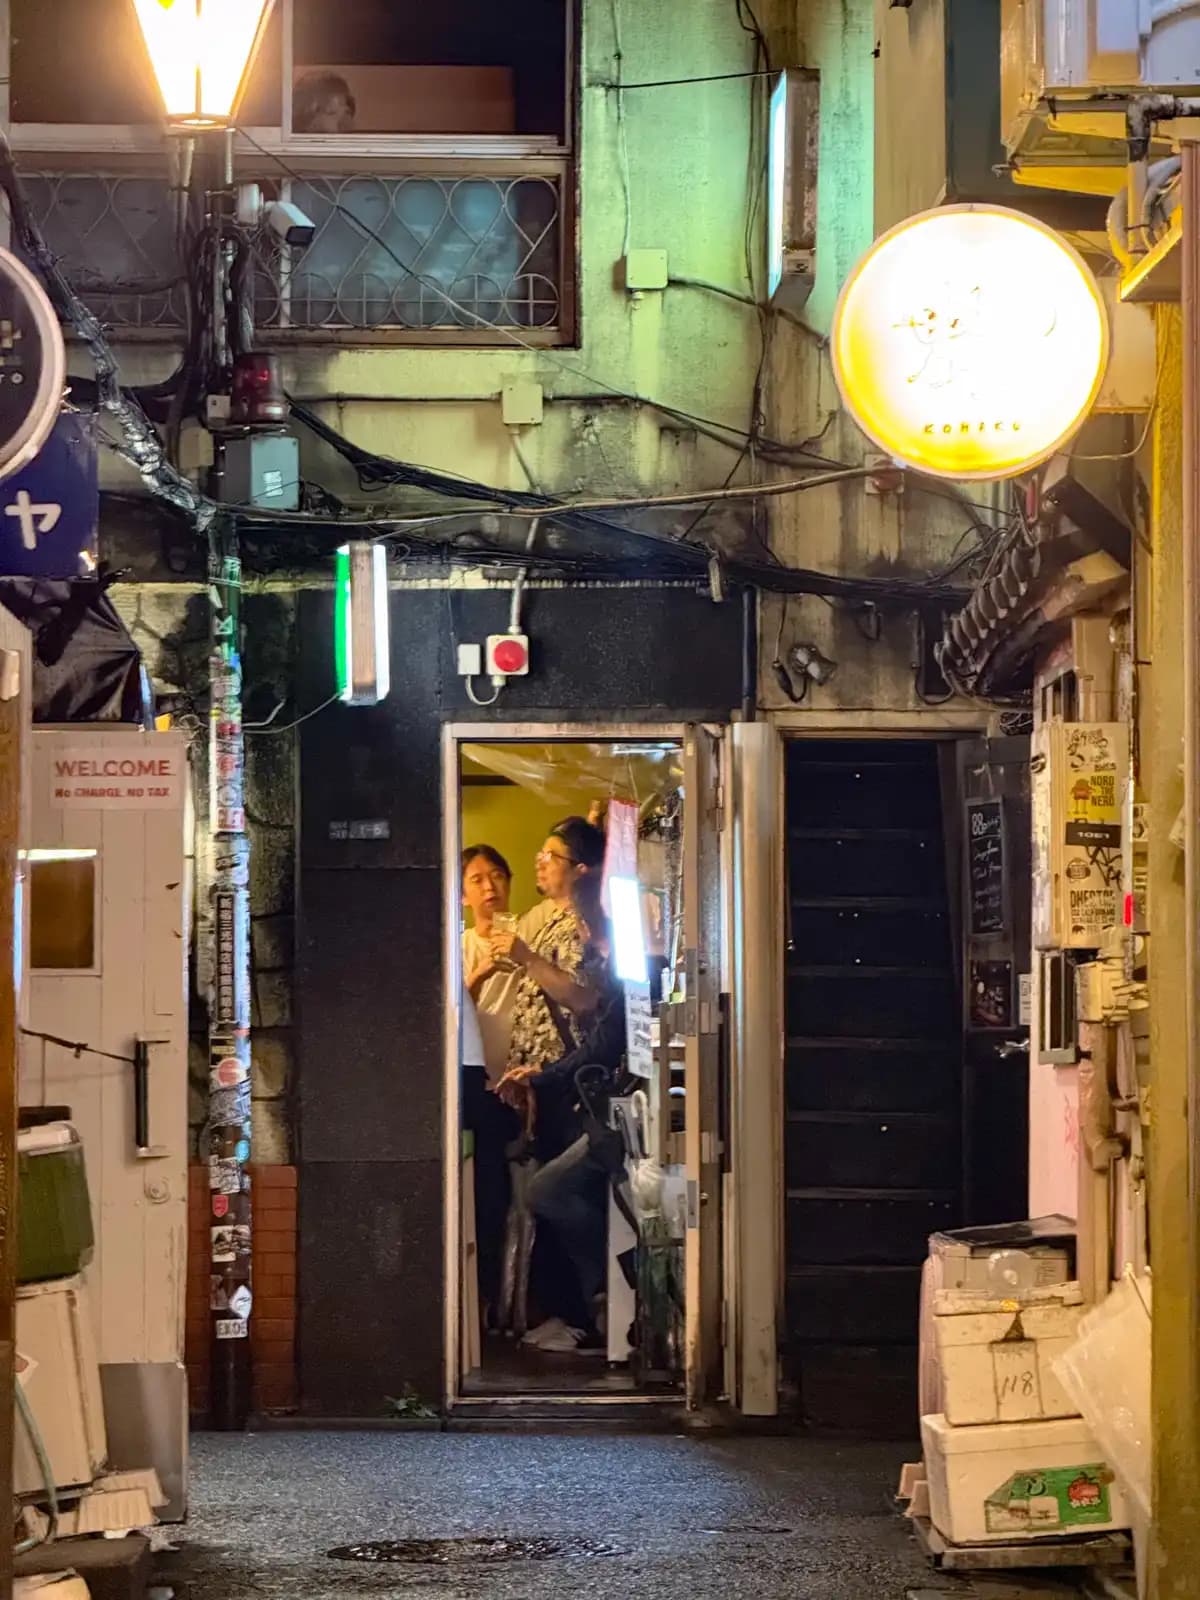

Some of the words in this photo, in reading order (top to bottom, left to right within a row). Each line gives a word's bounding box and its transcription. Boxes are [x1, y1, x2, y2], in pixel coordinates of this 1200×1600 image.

[5, 490, 61, 550] ヤ
[55, 760, 170, 776] WELCOME
[1001, 1370, 1033, 1398] 118
